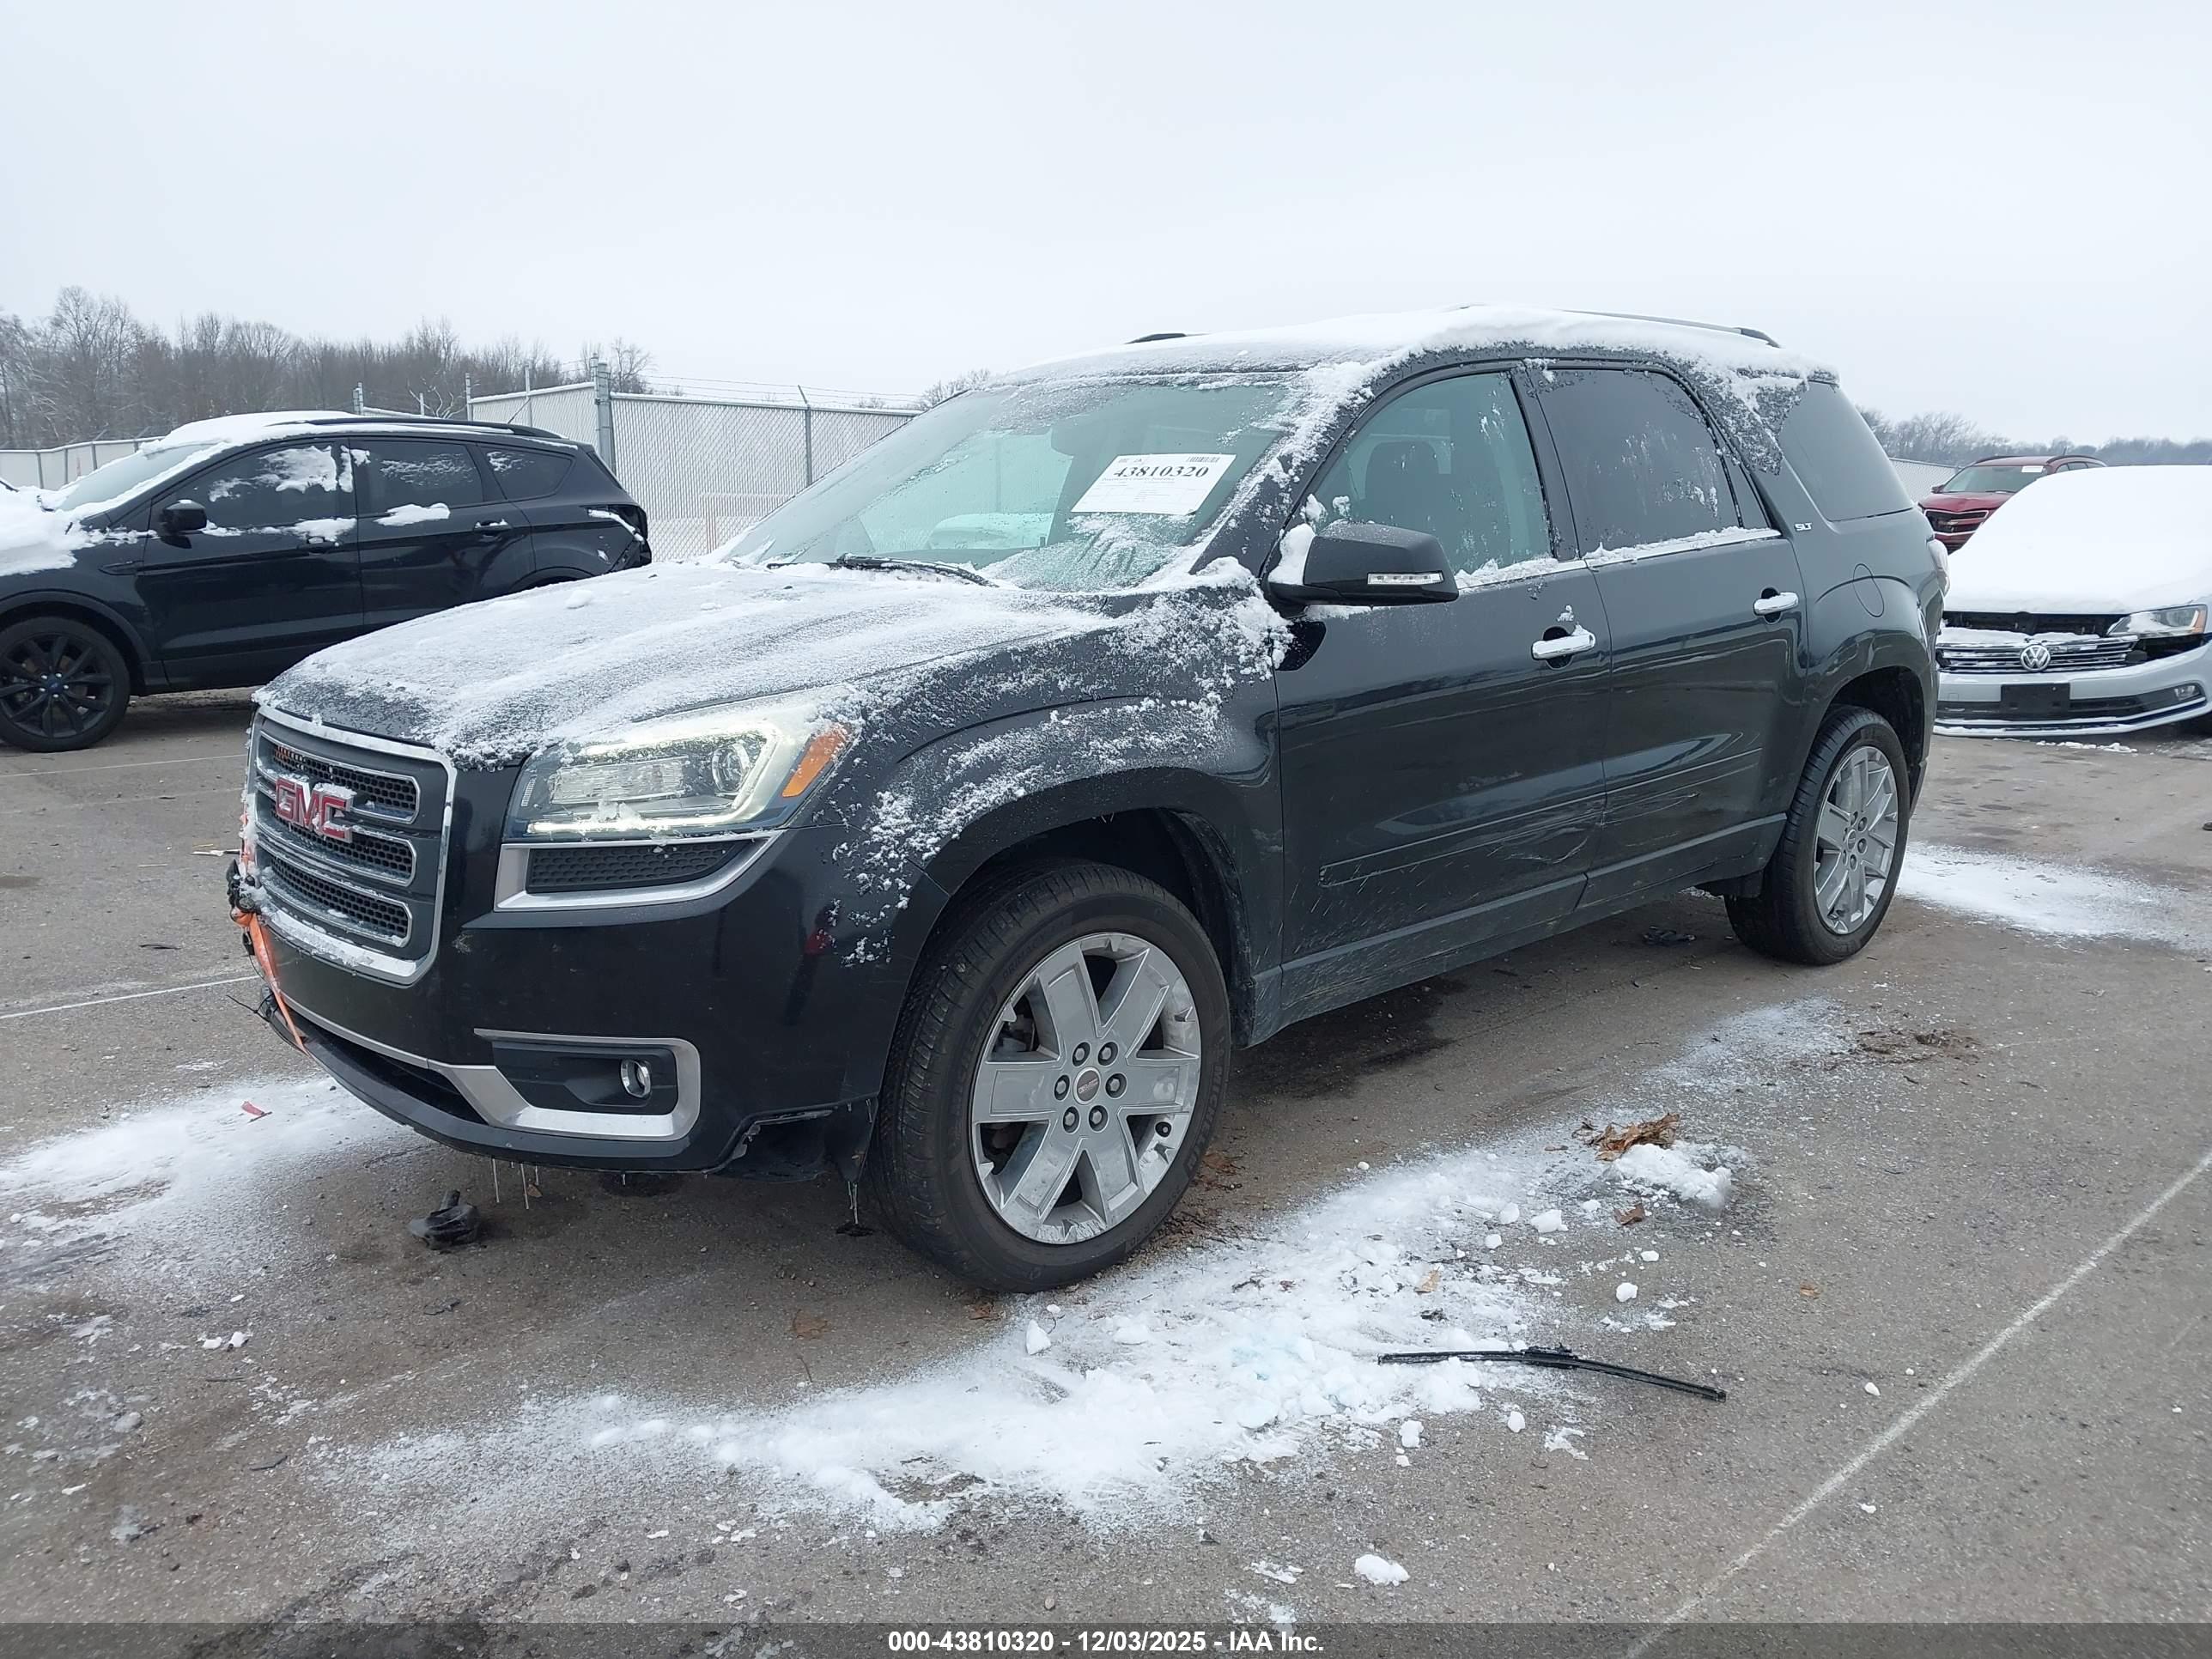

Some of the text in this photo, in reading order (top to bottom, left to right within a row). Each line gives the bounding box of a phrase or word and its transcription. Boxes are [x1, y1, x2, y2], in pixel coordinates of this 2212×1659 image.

[1113, 465, 1209, 478] 43810320
[1794, 522, 1812, 531] SLT
[275, 778, 353, 843] GMC
